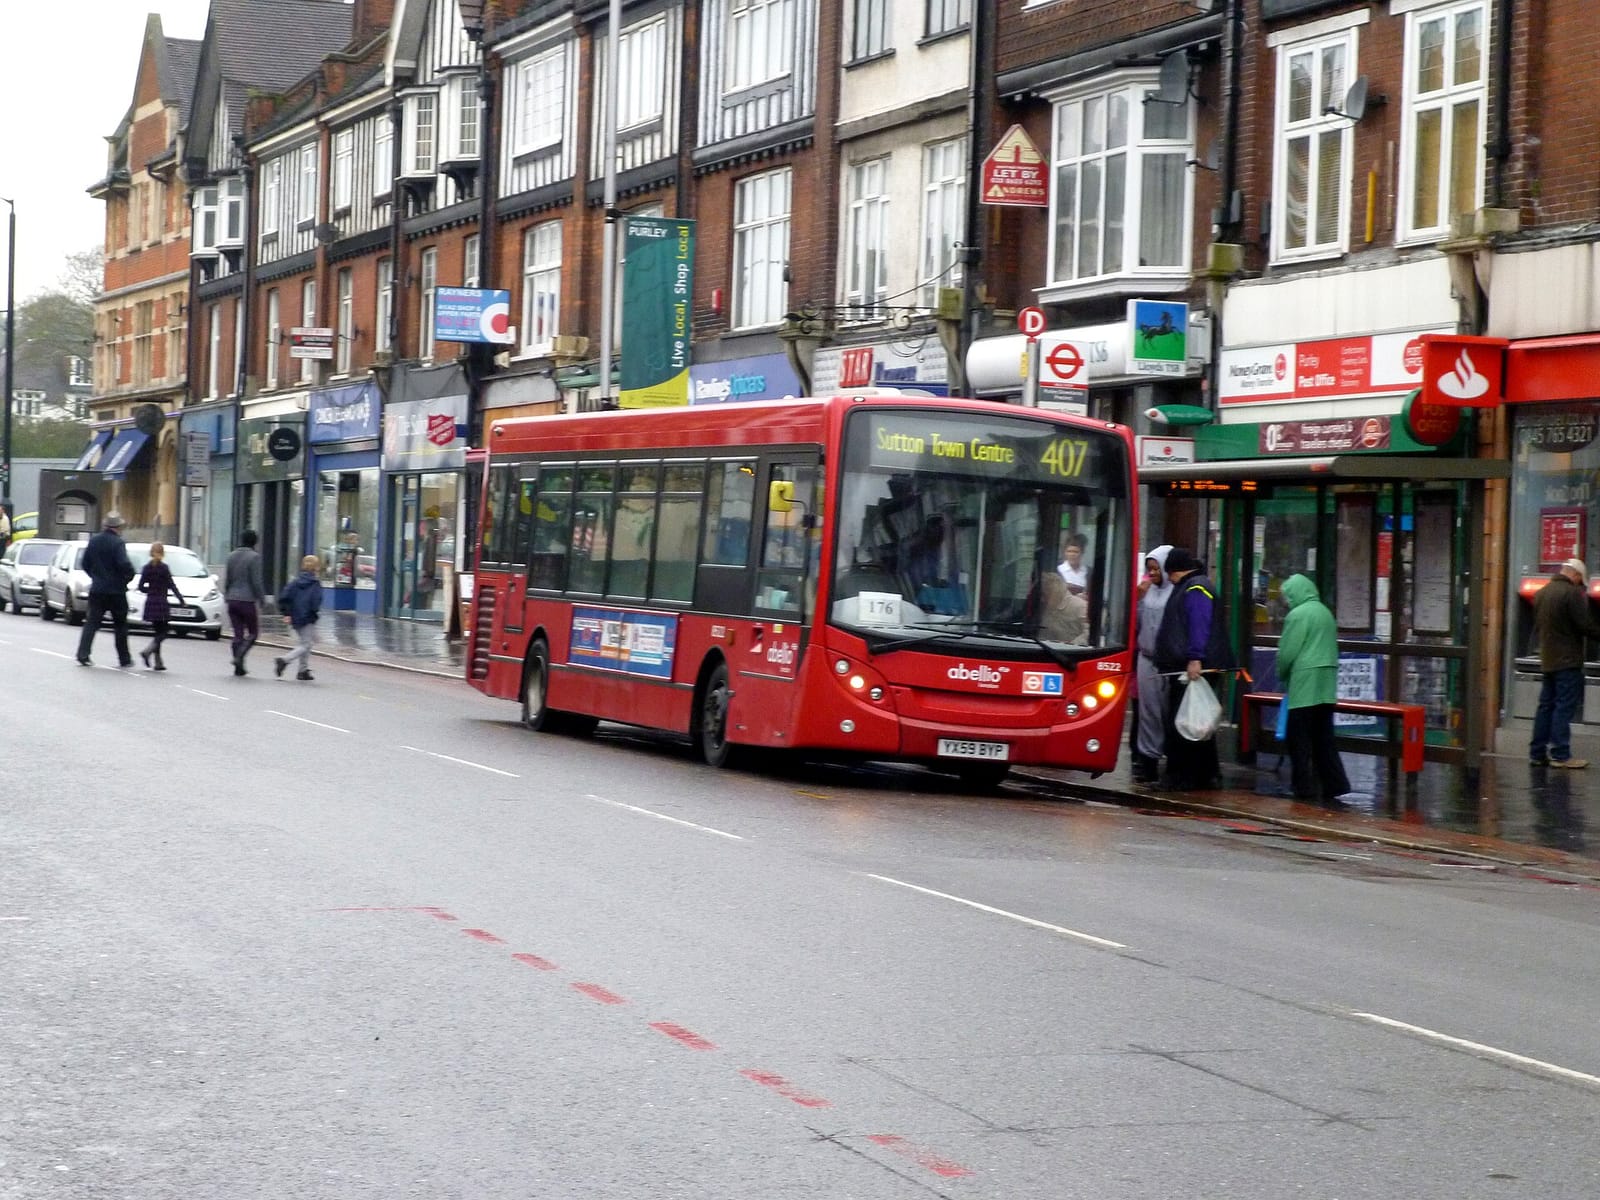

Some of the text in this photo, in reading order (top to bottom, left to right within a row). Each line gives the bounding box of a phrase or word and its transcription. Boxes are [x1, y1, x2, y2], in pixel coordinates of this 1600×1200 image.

[993, 169, 1040, 179] LET BY
[629, 226, 668, 237] PURLEY
[672, 226, 690, 367] Live Local, Shop Local
[1025, 311, 1044, 333] D
[1298, 373, 1336, 388] Post Office
[1566, 425, 1593, 442] 4321
[876, 426, 1015, 463] Sutton Town Centre
[1040, 438, 1088, 477] 407
[870, 601, 894, 614] 176
[767, 641, 793, 664] abellio
[948, 663, 1002, 683] abellio
[944, 740, 1004, 756] YX59 BYP
